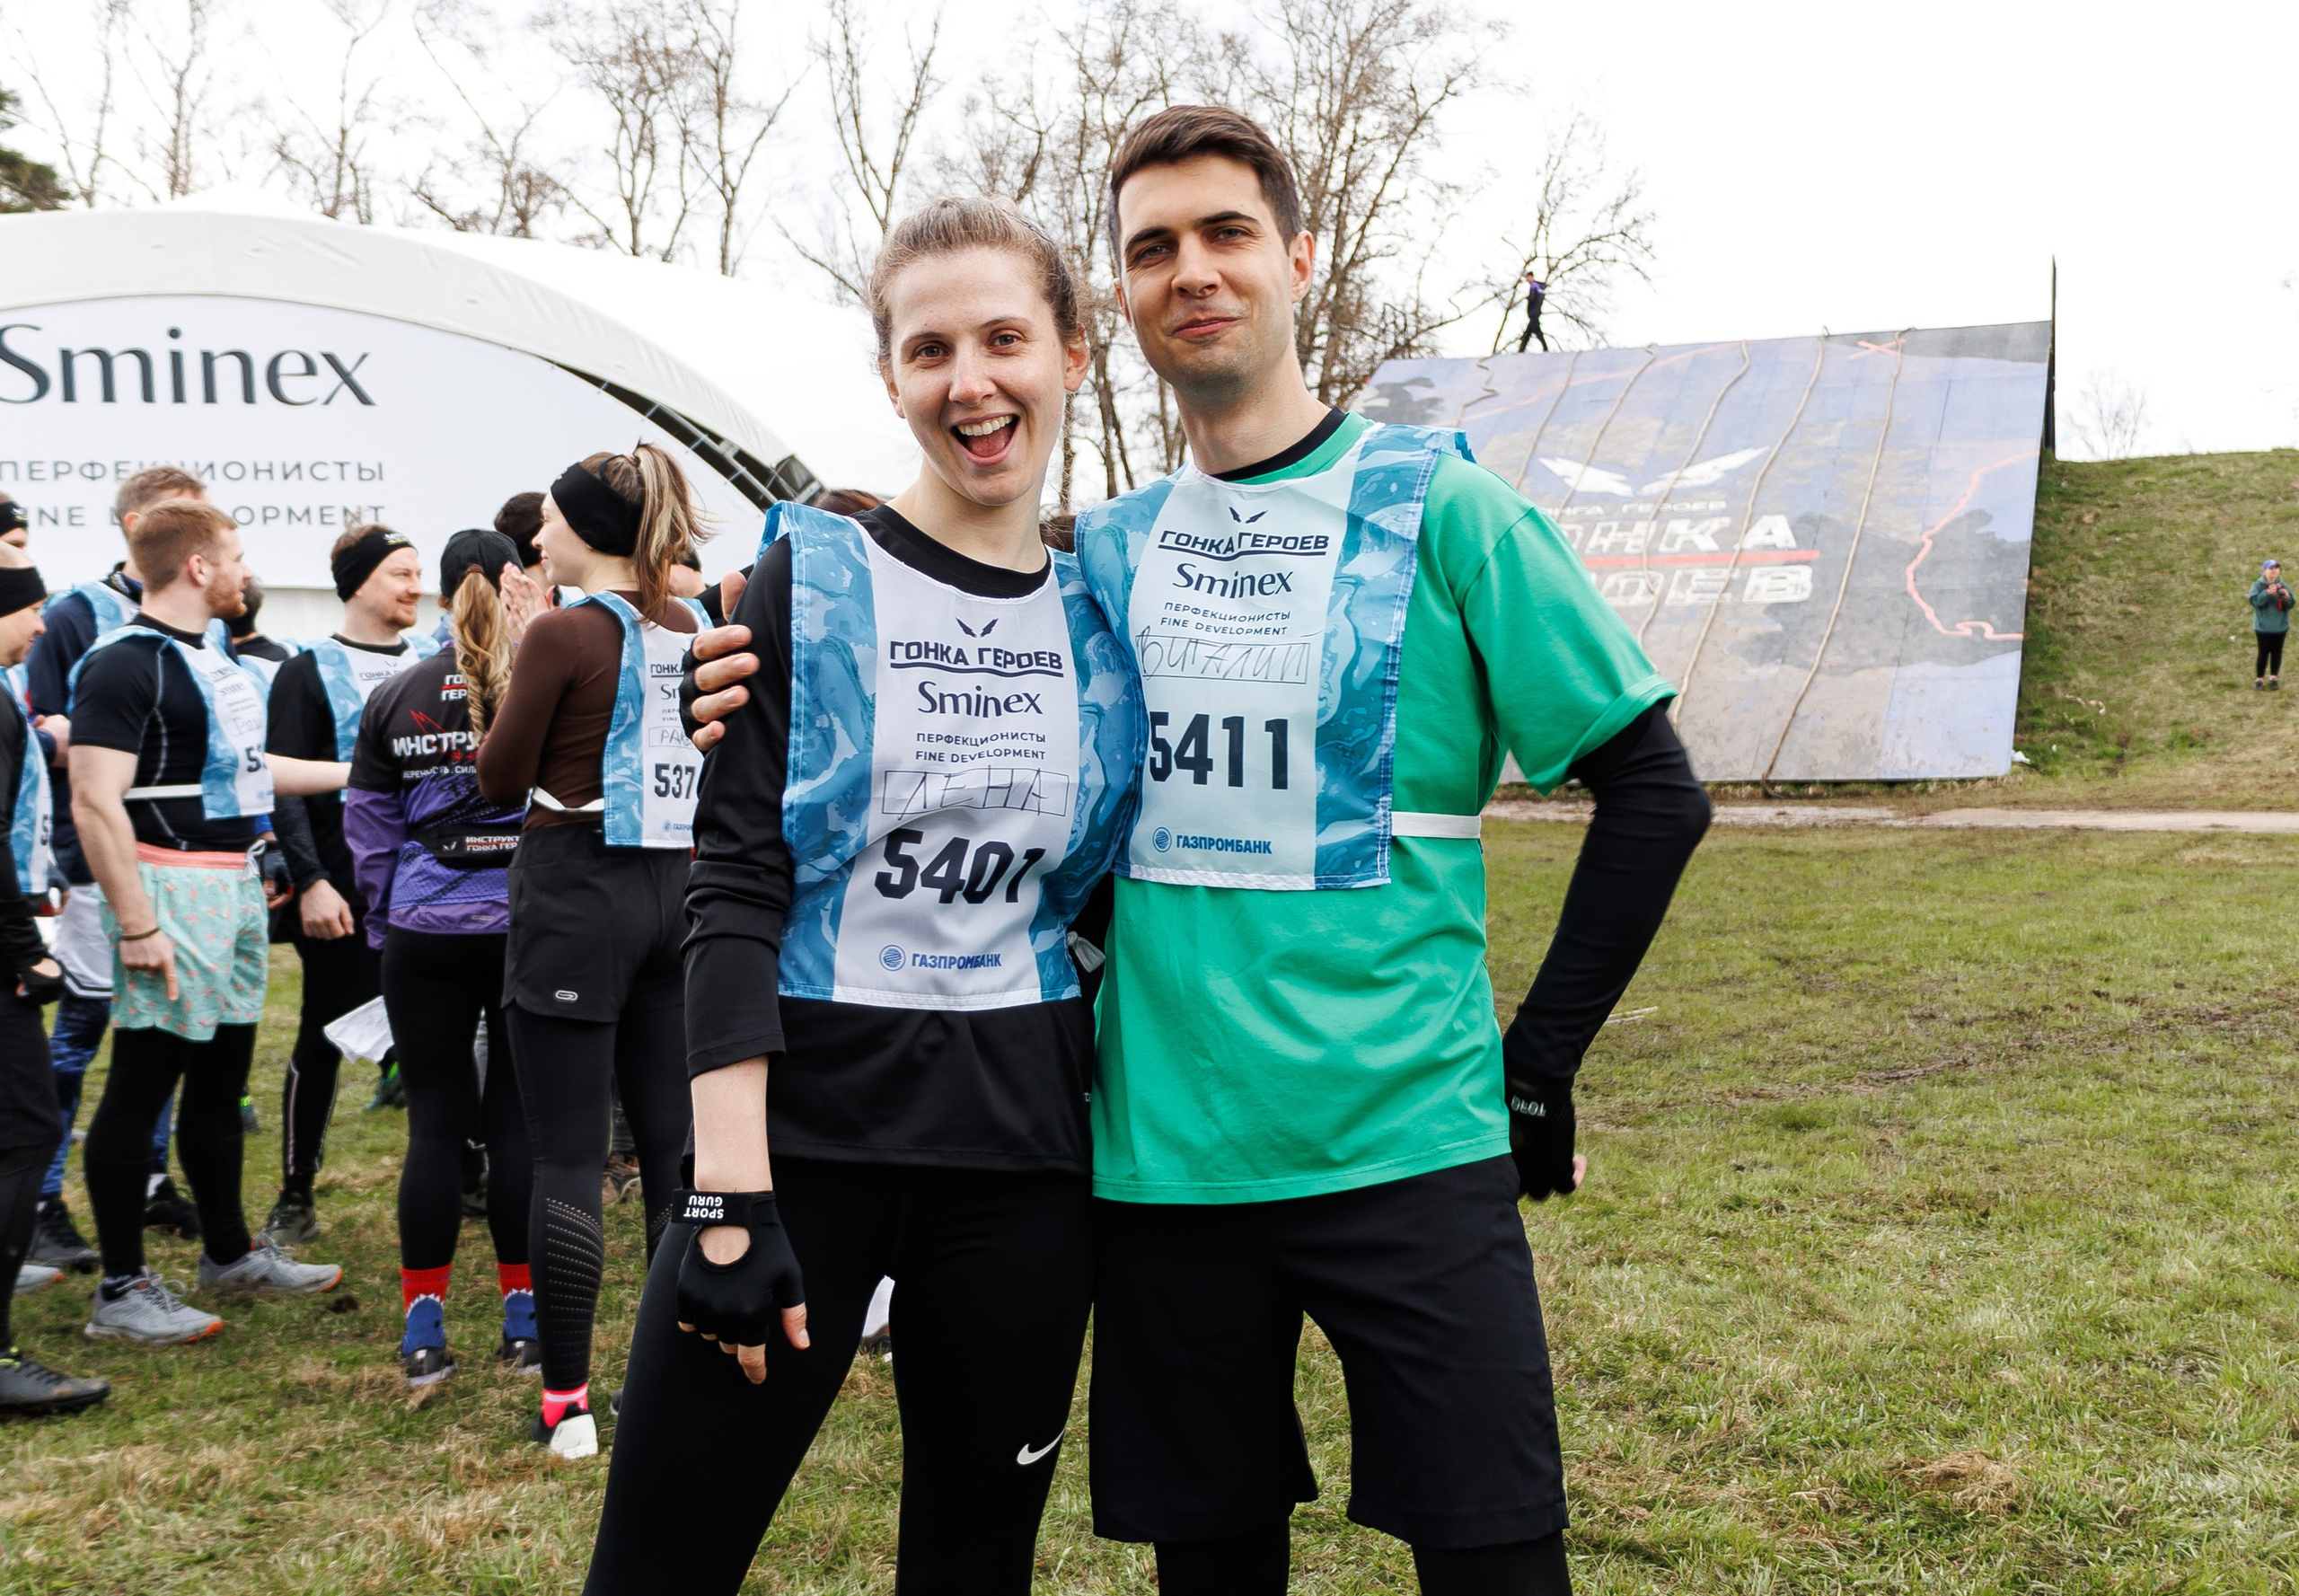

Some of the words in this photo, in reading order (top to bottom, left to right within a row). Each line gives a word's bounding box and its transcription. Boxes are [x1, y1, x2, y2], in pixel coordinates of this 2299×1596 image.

[0, 323, 377, 406] Sminex
[0, 460, 384, 481] ПЕРФЕИОНИСТЫ
[1159, 530, 1235, 555] ГОНКА
[1238, 532, 1330, 551] ГЕРОЕВ
[1561, 514, 1797, 555] НКА
[1172, 562, 1294, 599] Sminex
[1164, 602, 1291, 623] ПЕРФЕКЦИОНИСТЫ
[1160, 617, 1190, 628] FINE
[1194, 622, 1288, 636] DEVELOPMENT
[889, 640, 970, 666] ГОНКА
[977, 647, 1063, 670] ГЕРОЕВ
[918, 680, 1044, 718] Sminex
[916, 731, 1046, 747] ПЕРФЕКЦИОНИСТЫ
[1150, 710, 1289, 790] 5411
[915, 751, 945, 763] FINE
[950, 747, 1046, 763] DEVELOPMENT
[898, 765, 1050, 821] ЛЕНА
[1176, 834, 1273, 854] ГАЗПРОМБАНК
[874, 827, 1047, 904] 5401
[912, 952, 1002, 969] ГАЗПРОМБАНК
[689, 1195, 723, 1206] GURU
[683, 1207, 724, 1219] SPORT
